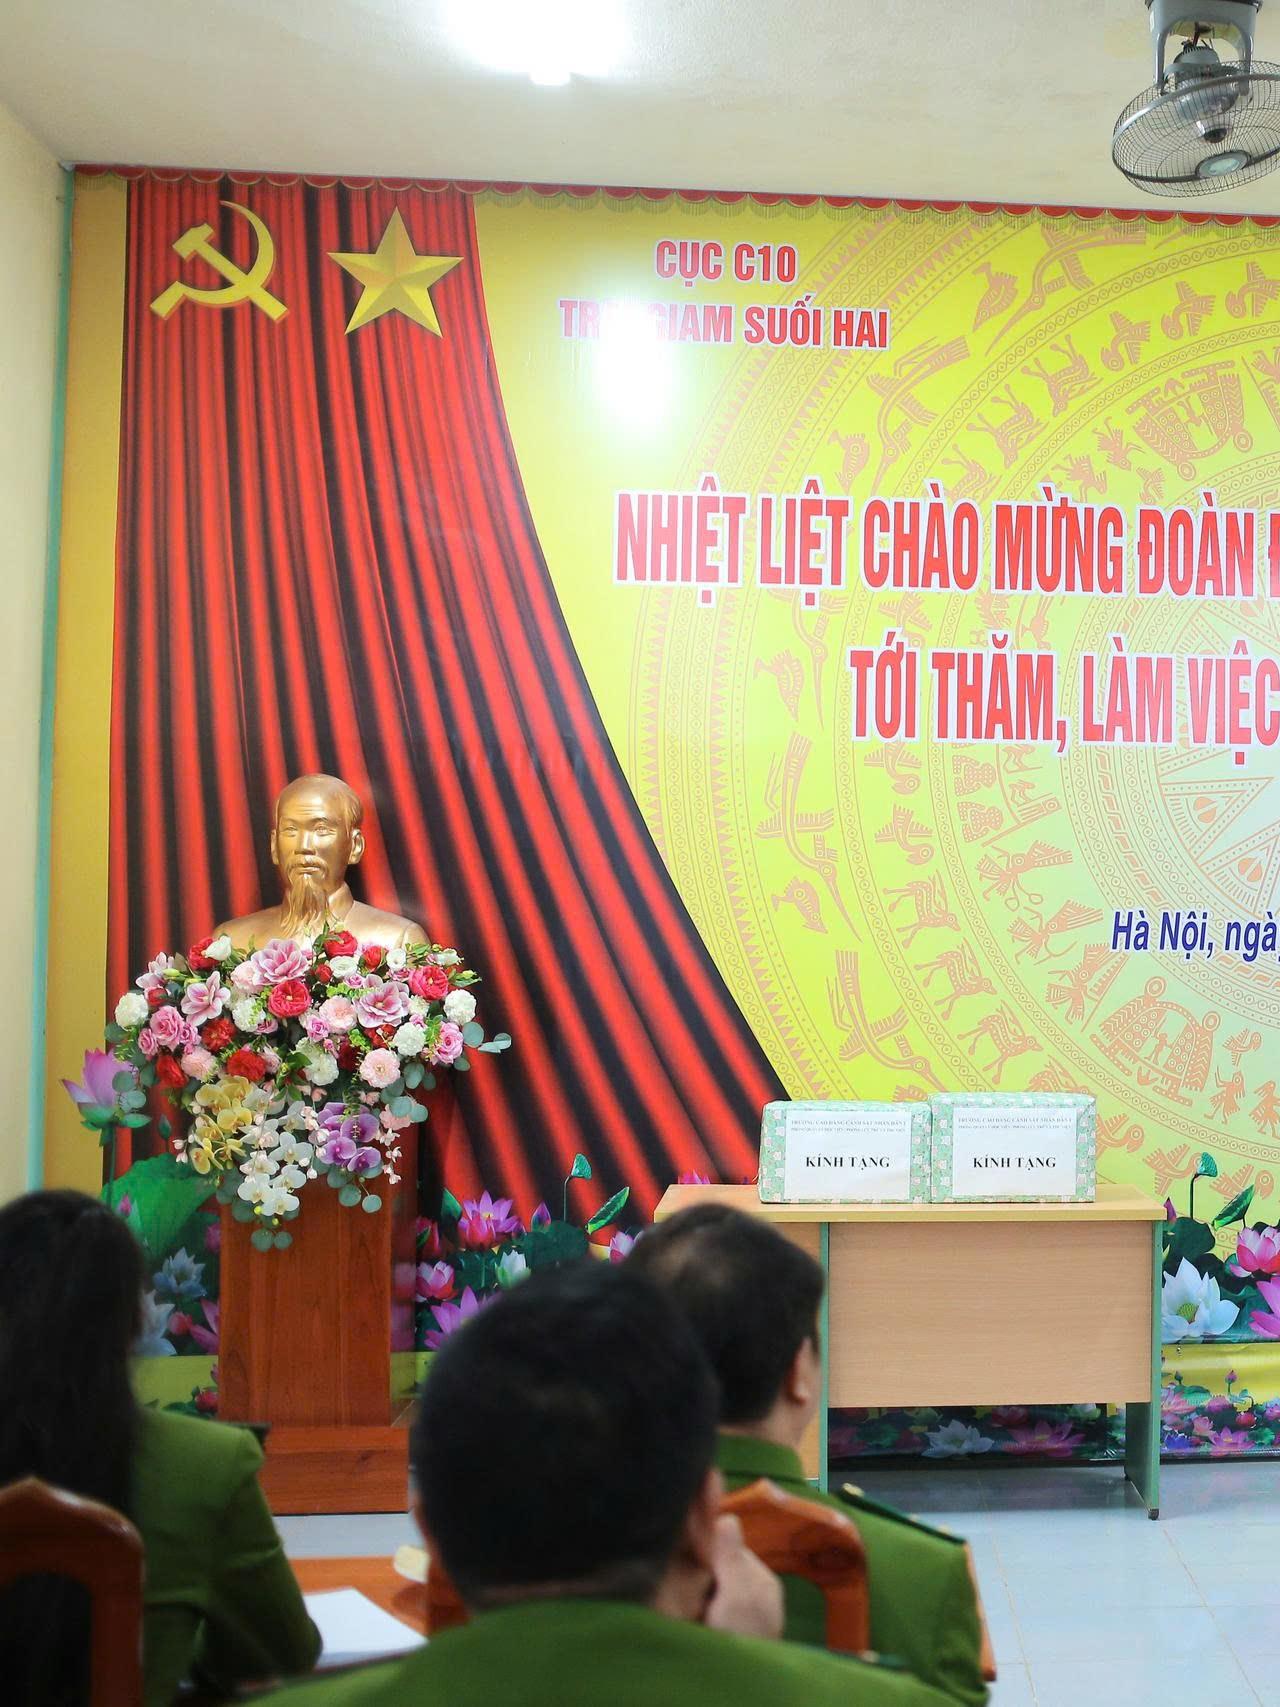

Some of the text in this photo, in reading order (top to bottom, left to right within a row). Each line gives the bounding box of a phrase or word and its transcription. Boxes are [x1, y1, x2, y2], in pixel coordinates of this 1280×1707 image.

[656, 240, 796, 287] CỤC C10
[744, 295, 822, 346] SUỐI
[833, 310, 887, 348] HAI
[617, 477, 746, 604] NHIỆT
[760, 480, 849, 606] LIỆT
[863, 483, 979, 592] CHÀO
[996, 486, 1124, 595] MỪNG
[1137, 492, 1255, 597] ĐOÀN
[850, 632, 916, 739] TỚI
[932, 635, 1066, 753] THĂM,
[1083, 637, 1172, 743] LÀM
[1188, 642, 1280, 765] VIỆC
[1112, 910, 1150, 950] Hà
[1159, 911, 1213, 960] Nội,
[806, 1153, 890, 1171] KÍNH TẠNG
[973, 1154, 1056, 1171] KÍNH TẠNG
